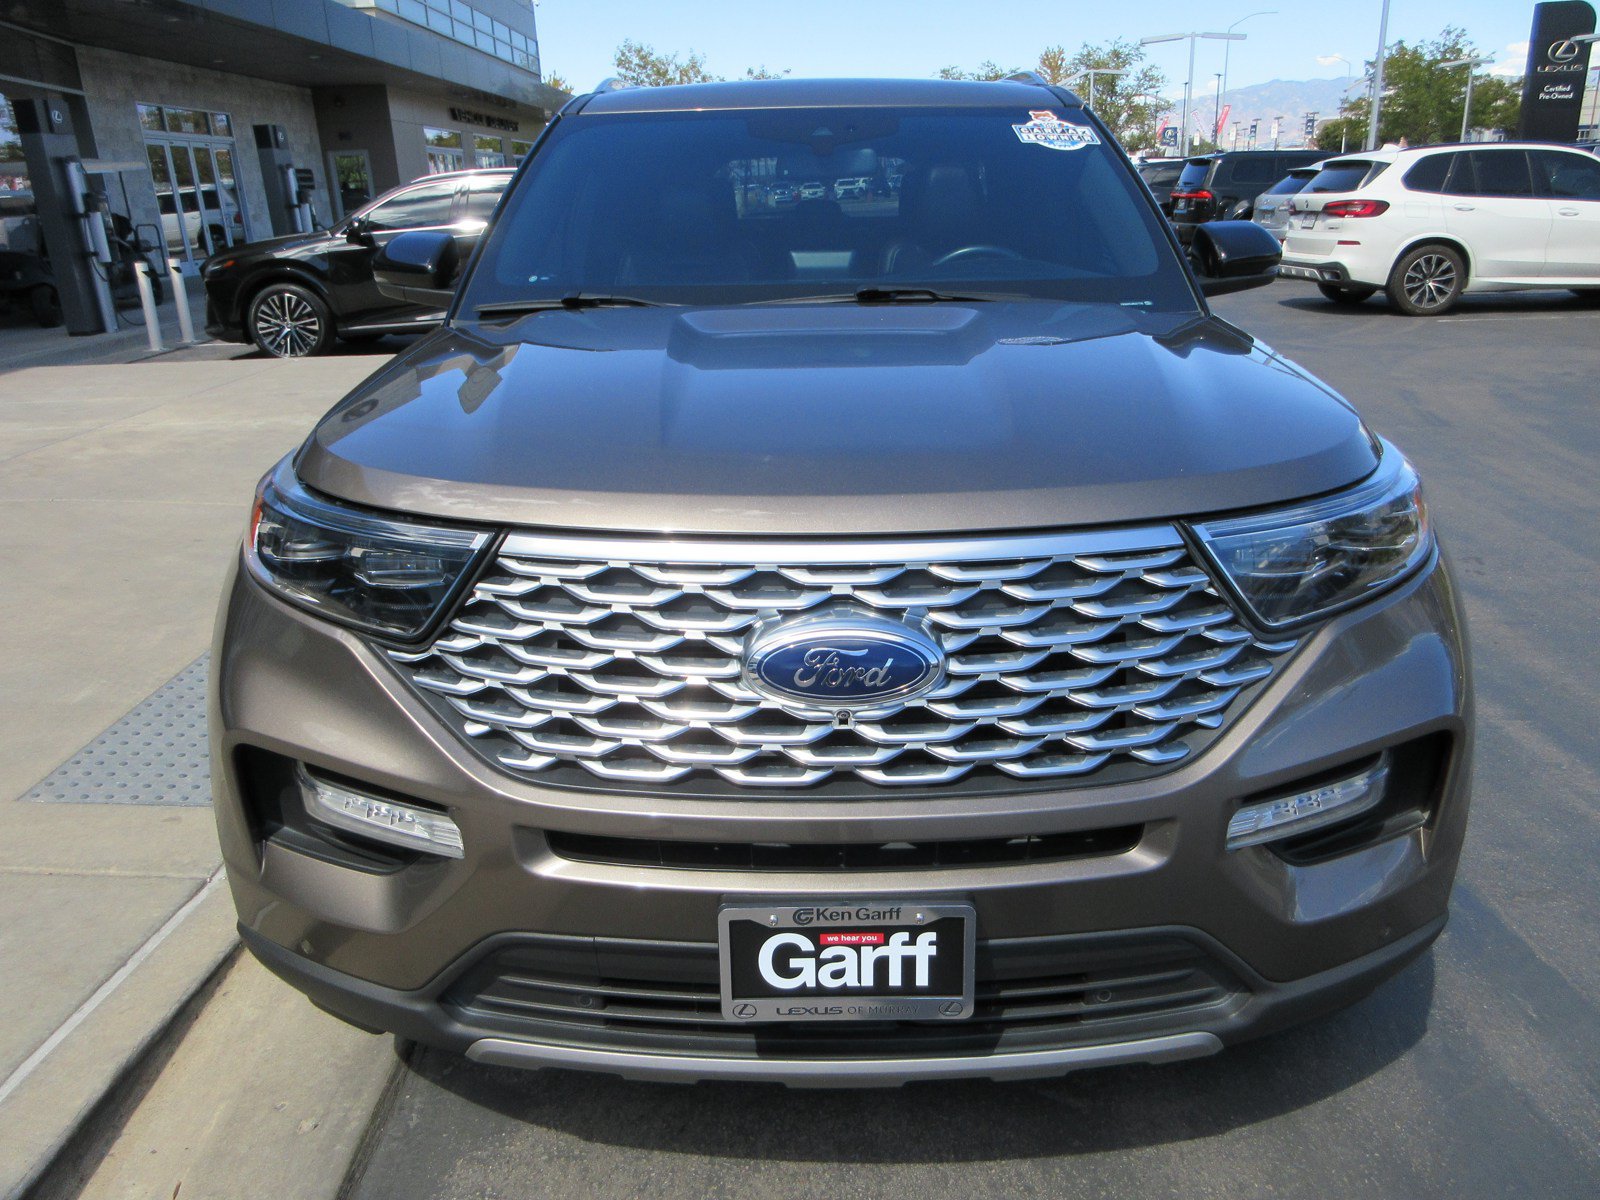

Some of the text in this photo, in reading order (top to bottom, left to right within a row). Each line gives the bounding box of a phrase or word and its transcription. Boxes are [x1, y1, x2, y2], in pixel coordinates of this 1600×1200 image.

[1539, 92, 1573, 100] Pre-Owned
[794, 647, 894, 687] Ford
[816, 907, 902, 921] Ken Garff
[861, 935, 877, 943] you
[758, 931, 937, 989] Garff
[777, 1005, 919, 1016] LEXUS OF MURRAY
